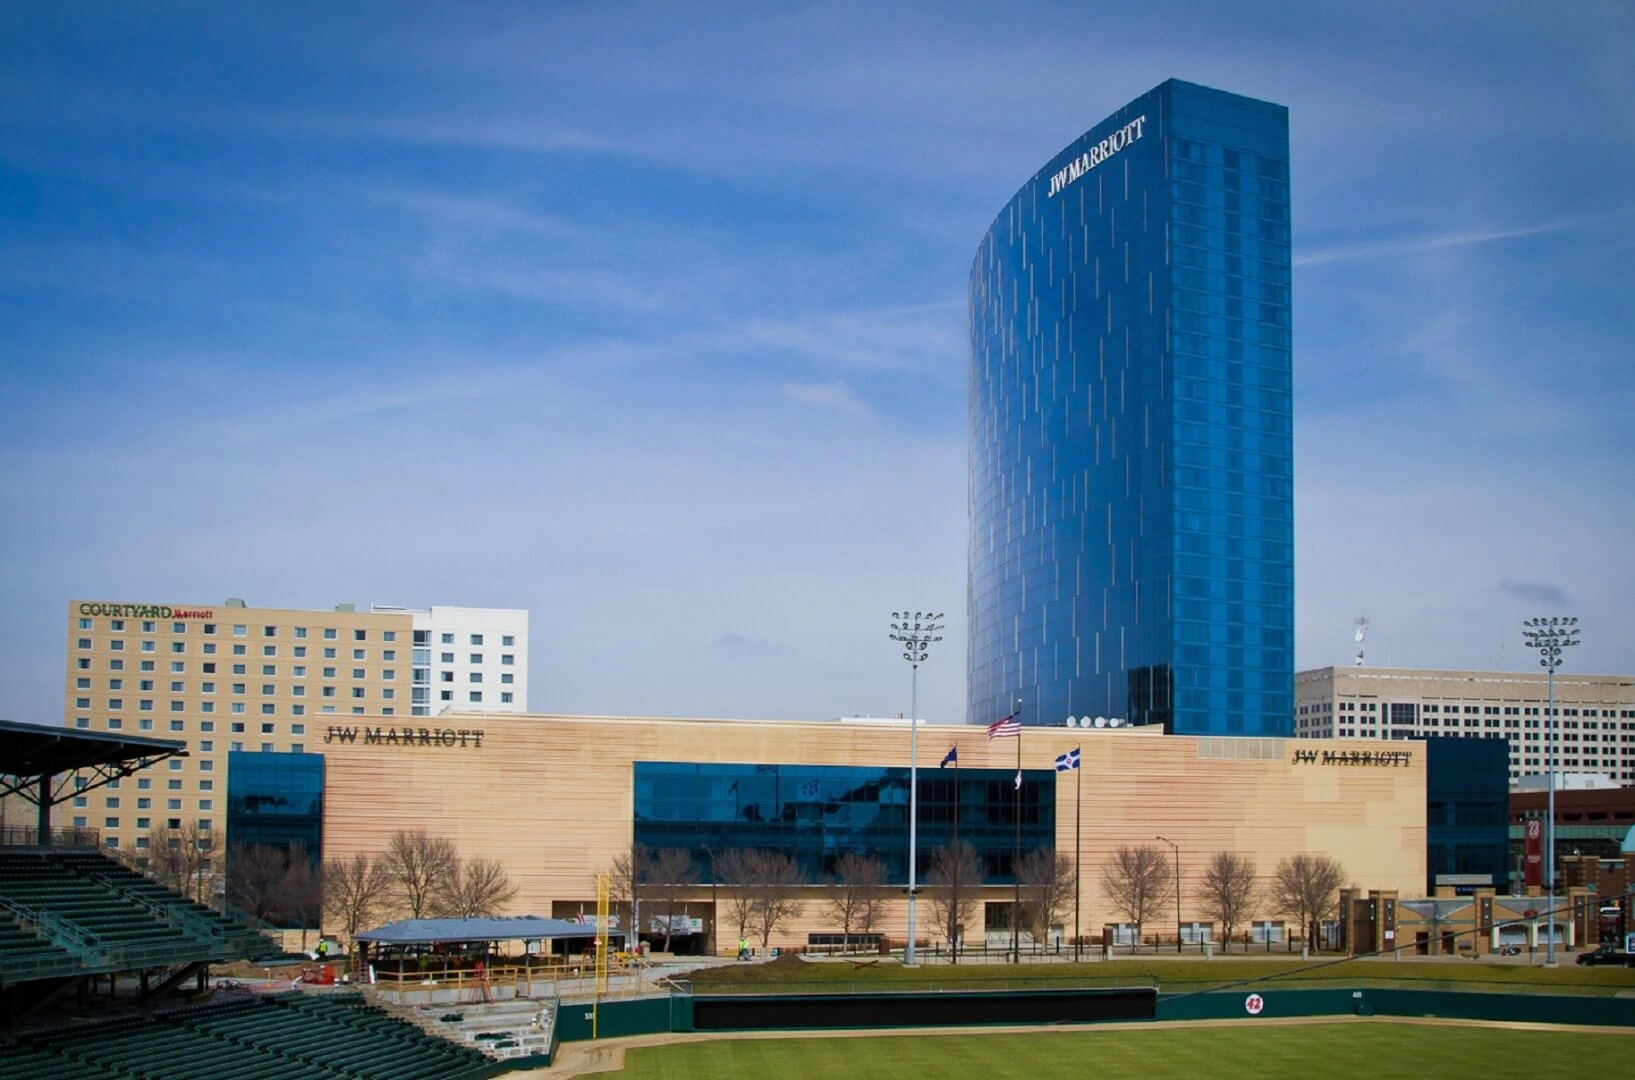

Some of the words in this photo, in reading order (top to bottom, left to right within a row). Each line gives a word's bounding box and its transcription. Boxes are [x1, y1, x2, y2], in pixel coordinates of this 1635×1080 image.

[1048, 166, 1069, 198] JW
[1067, 115, 1145, 185] MARRIOTT
[79, 602, 172, 619] COURTYARD
[171, 609, 213, 620] Marriott
[323, 726, 359, 744] JW
[363, 727, 485, 748] MARRIOTT
[1292, 749, 1319, 766] JW
[1321, 750, 1413, 767] MARRIOTT
[1247, 997, 1261, 1010] 42
